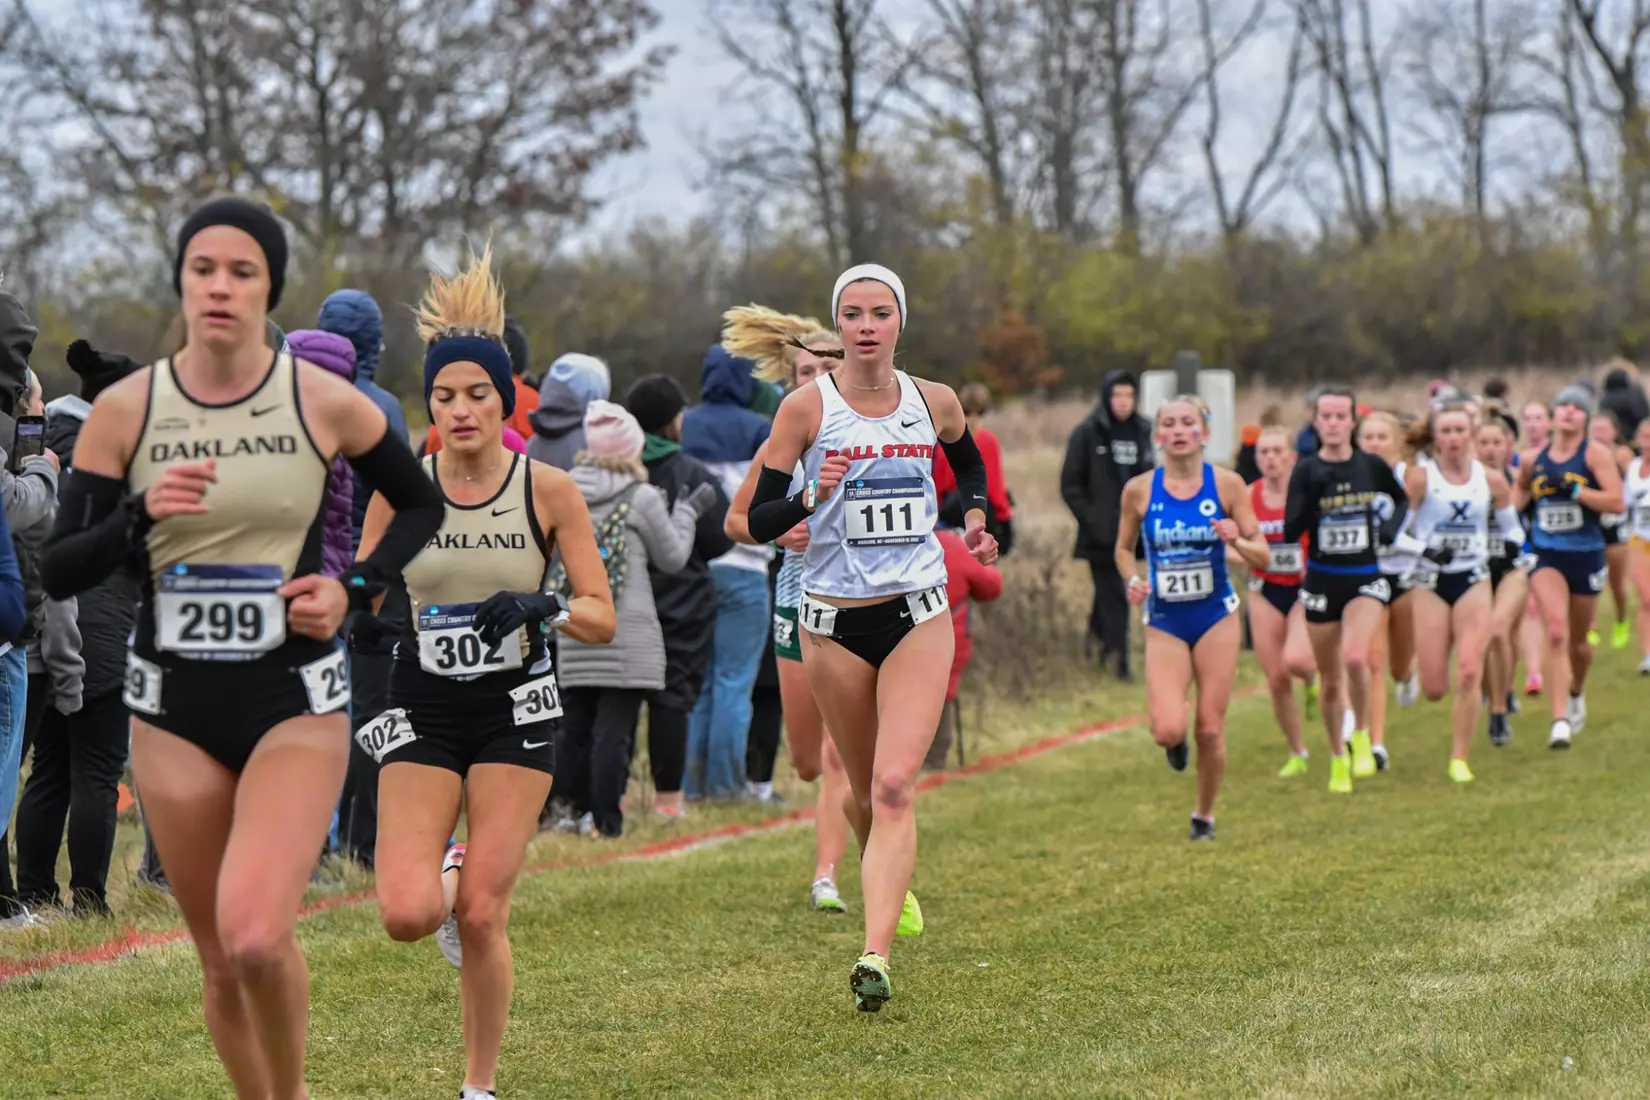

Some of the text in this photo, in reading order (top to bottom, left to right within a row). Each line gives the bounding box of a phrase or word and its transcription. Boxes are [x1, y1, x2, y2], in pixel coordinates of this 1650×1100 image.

[151, 435, 298, 463] OAKLAND
[860, 502, 912, 533] 111
[1450, 501, 1470, 521] X
[426, 533, 526, 549] AKLAND
[1166, 573, 1202, 593] 211
[177, 602, 264, 643] 299
[434, 633, 505, 669] 302
[361, 716, 402, 757] 302
